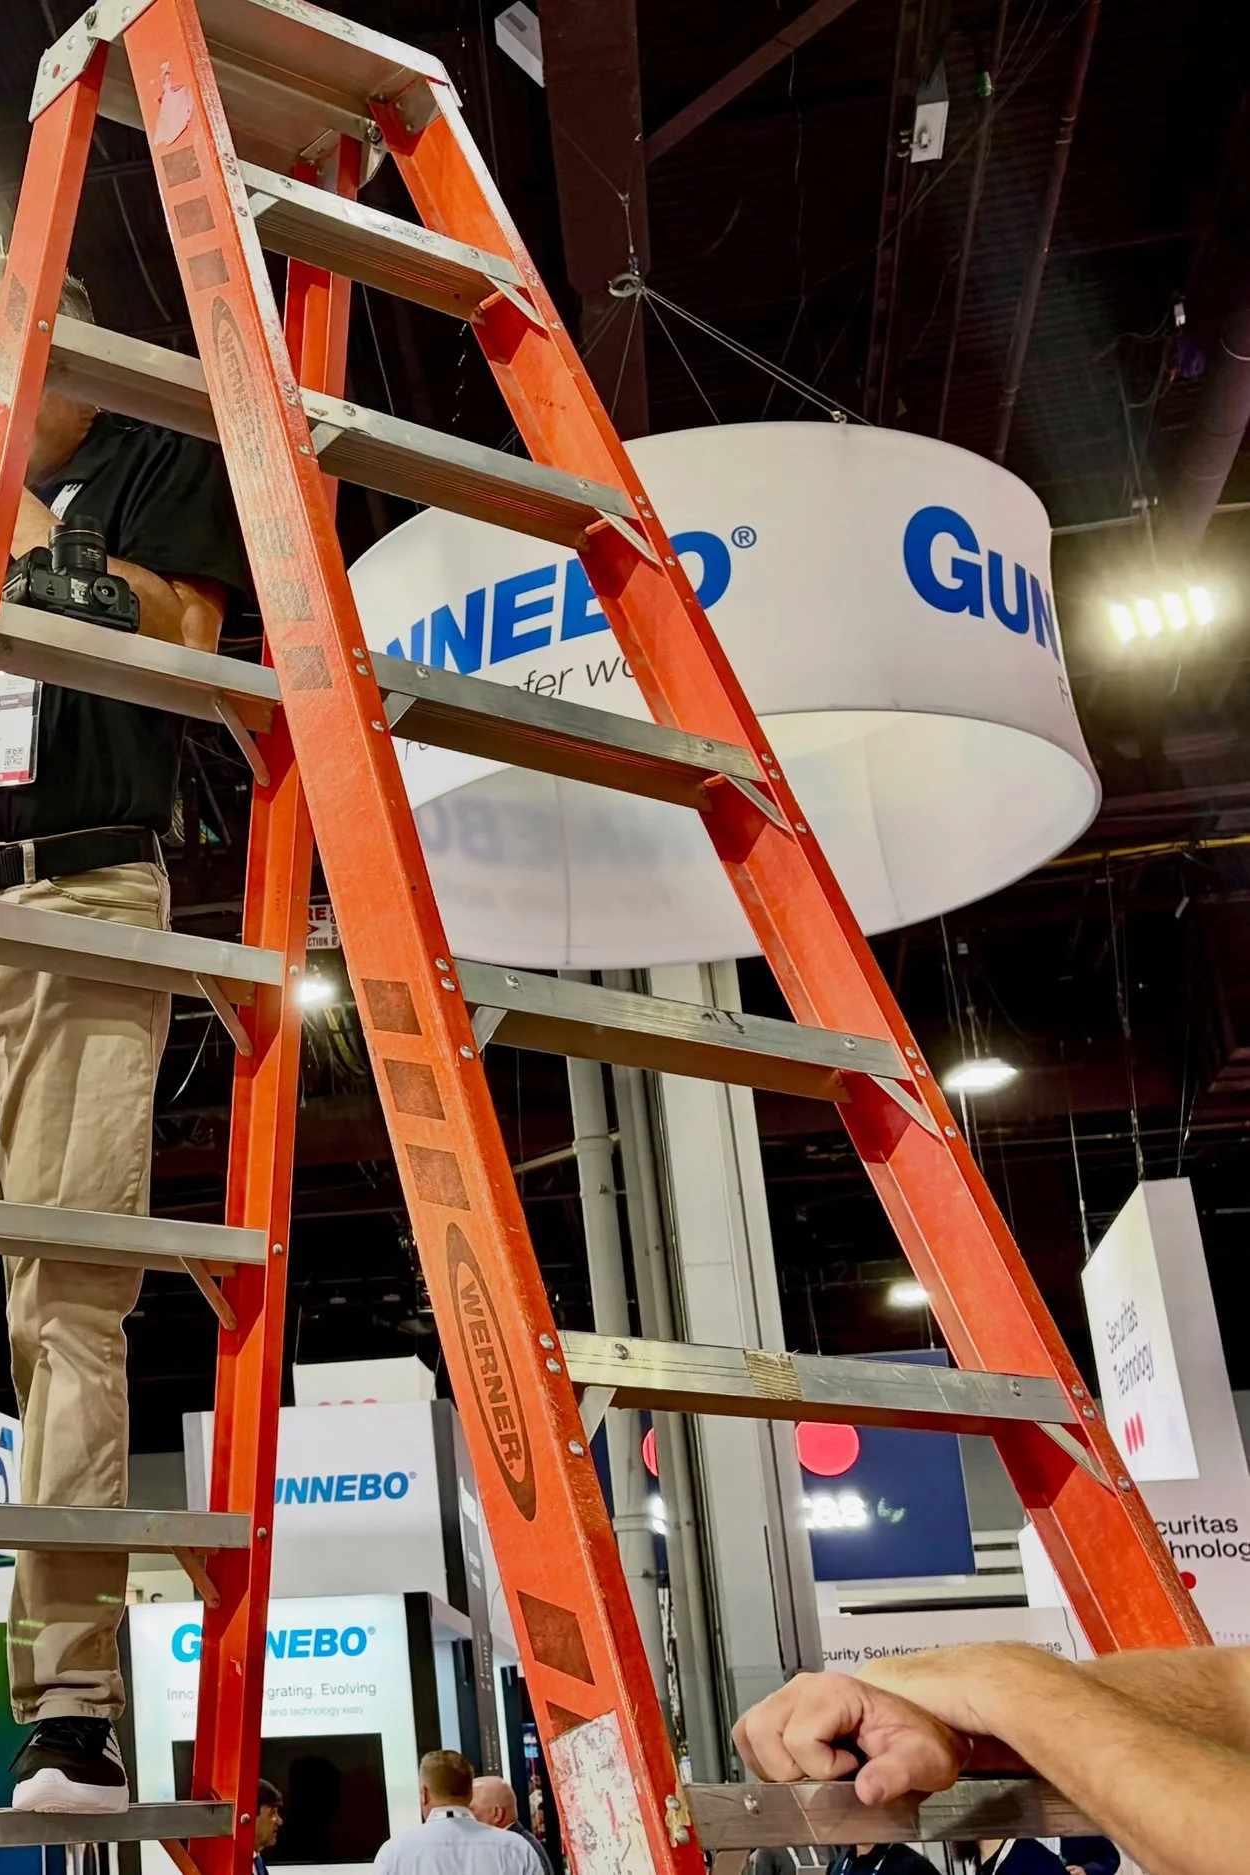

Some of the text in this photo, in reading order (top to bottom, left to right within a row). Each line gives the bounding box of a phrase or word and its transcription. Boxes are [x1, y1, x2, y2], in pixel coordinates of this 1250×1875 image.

[1105, 1301, 1139, 1354] Securitas
[460, 1280, 524, 1463] WERNER
[1113, 1341, 1155, 1399] Technology
[321, 1682, 377, 1698] Evolving
